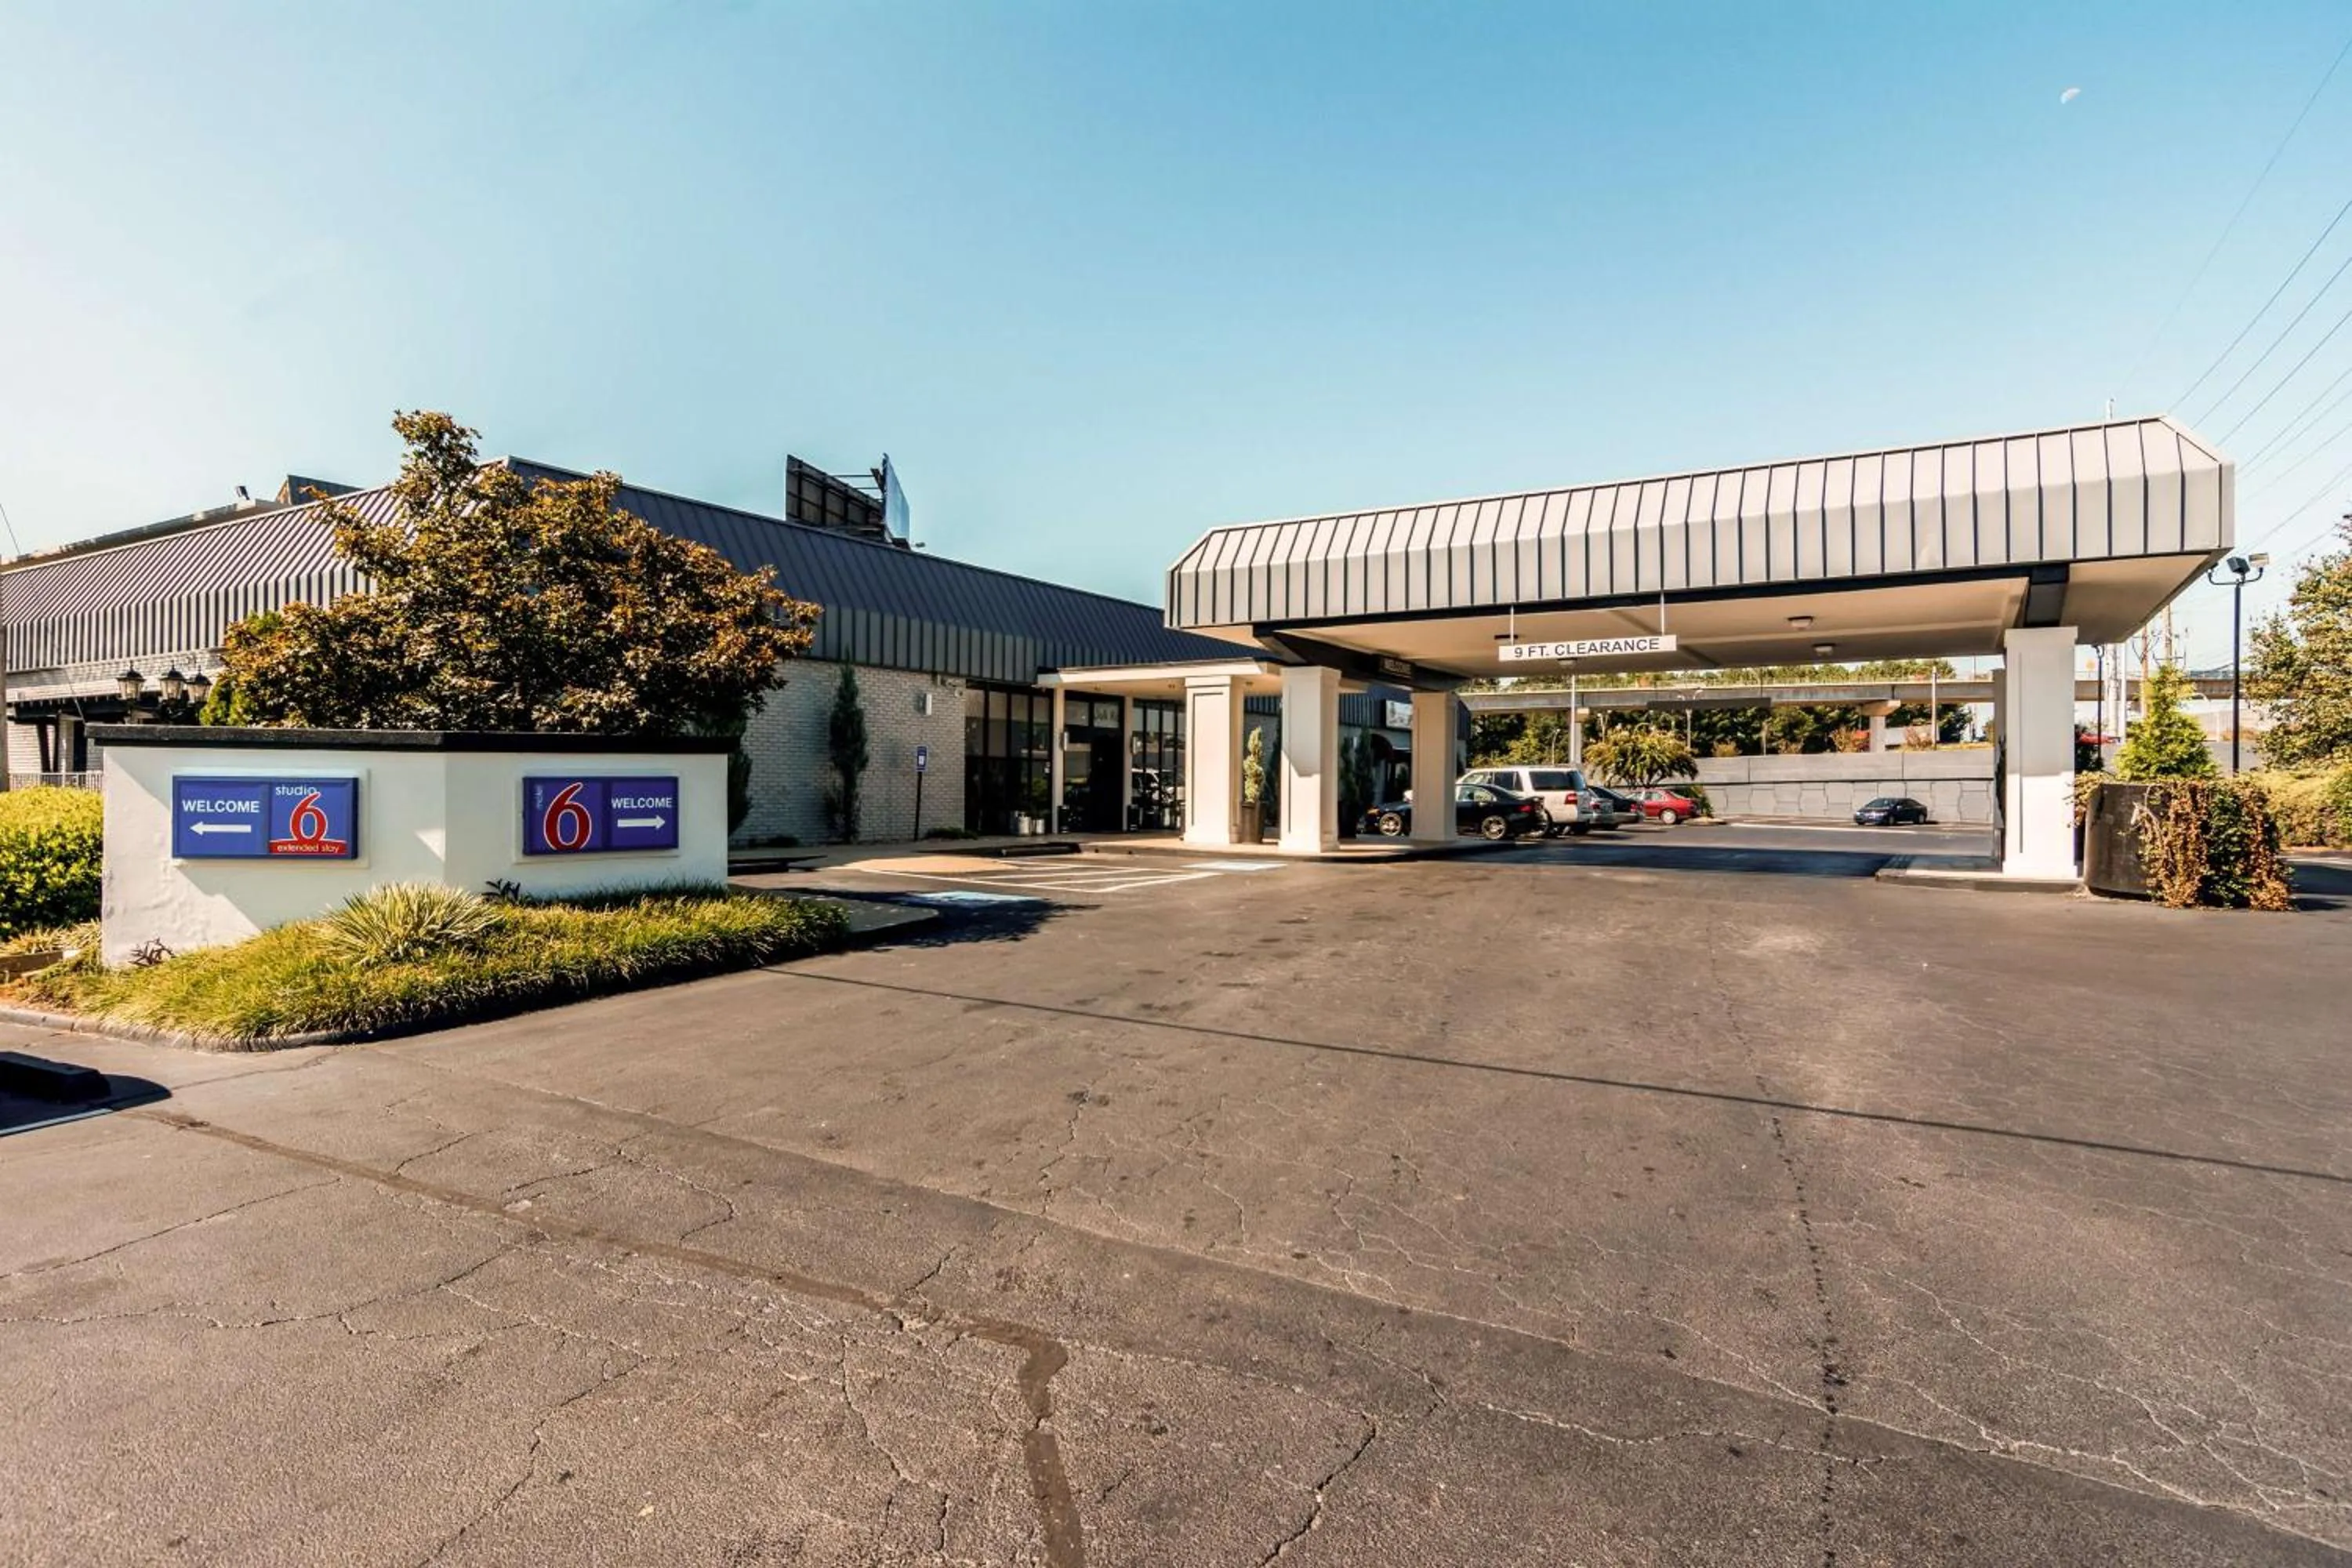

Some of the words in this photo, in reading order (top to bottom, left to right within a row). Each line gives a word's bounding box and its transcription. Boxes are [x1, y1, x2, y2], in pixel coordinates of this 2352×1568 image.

[1514, 647, 1523, 658] 9
[1528, 645, 1550, 657] FT.
[1555, 637, 1661, 656] CLEARANCE
[275, 785, 318, 796] studio
[182, 800, 260, 814] WELCOME
[612, 797, 673, 809] WELCOME
[289, 791, 328, 843] 6
[543, 782, 592, 850] 6
[277, 843, 319, 852] extended
[321, 843, 339, 854] stay
